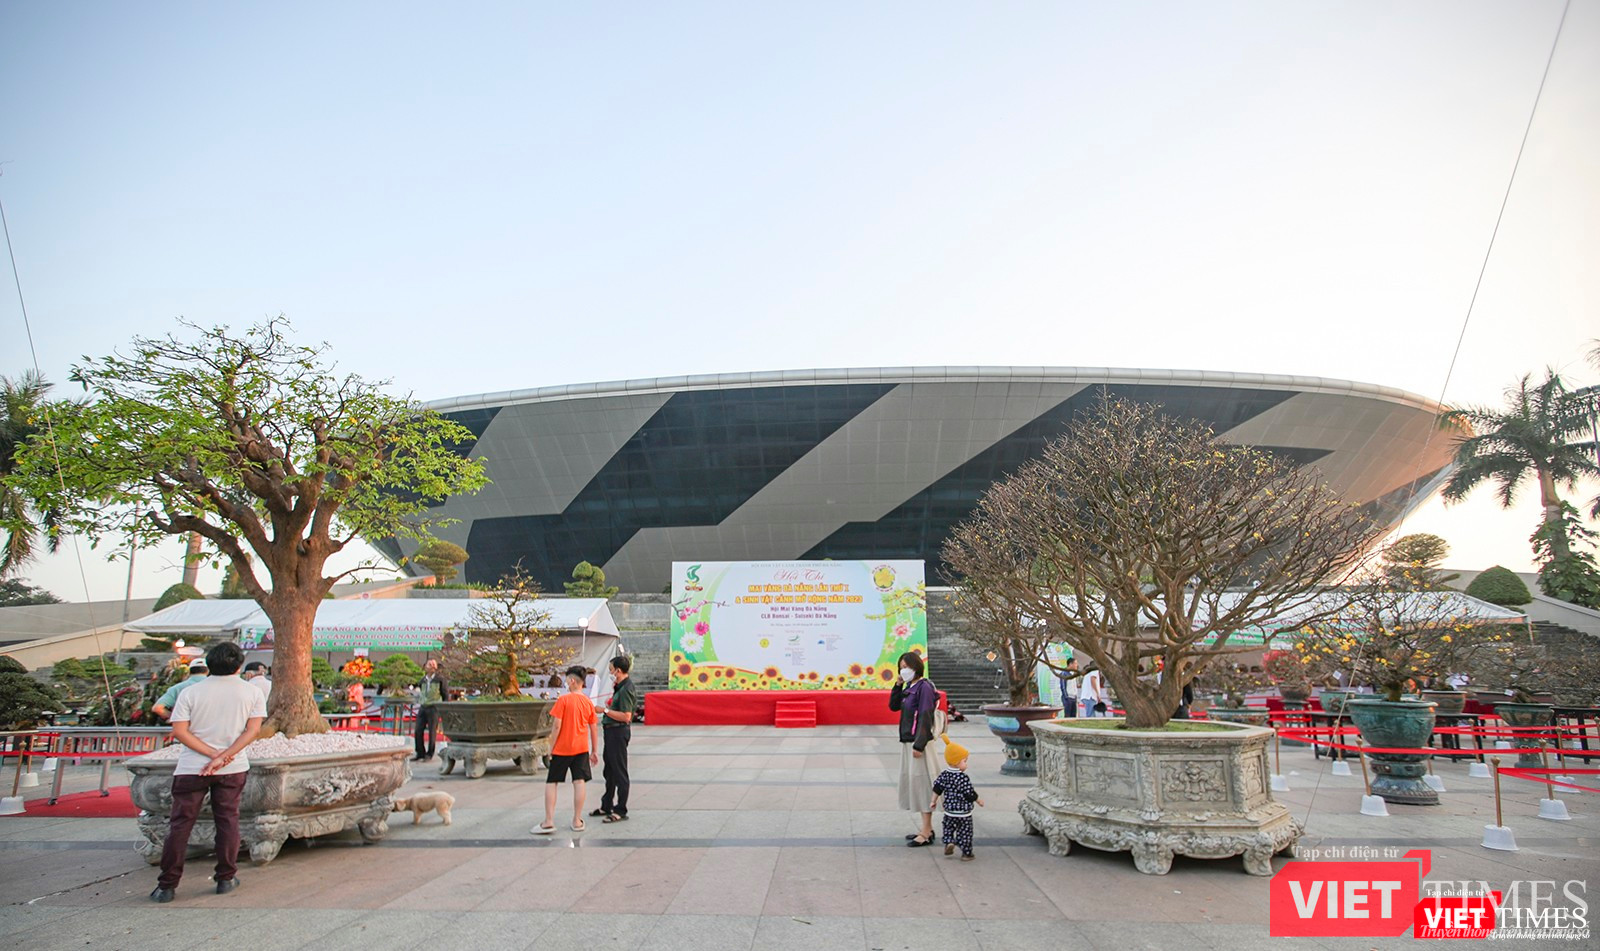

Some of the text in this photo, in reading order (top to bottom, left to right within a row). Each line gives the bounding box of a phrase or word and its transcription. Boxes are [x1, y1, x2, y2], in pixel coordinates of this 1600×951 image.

[773, 569, 825, 582] Hội Thi
[748, 584, 762, 593] MAI
[763, 583, 782, 593] VÀNG
[783, 583, 793, 593] ĐÀ
[793, 582, 814, 593] NẴNG
[815, 582, 829, 592] LẦN
[830, 583, 844, 592] THỨ
[735, 596, 741, 604] &
[742, 595, 759, 604] SINH
[760, 594, 773, 605] VẬT
[774, 593, 793, 604] CẢNH
[795, 593, 807, 603] MỞ
[808, 593, 827, 604] RỘNG
[828, 593, 844, 603] NĂM
